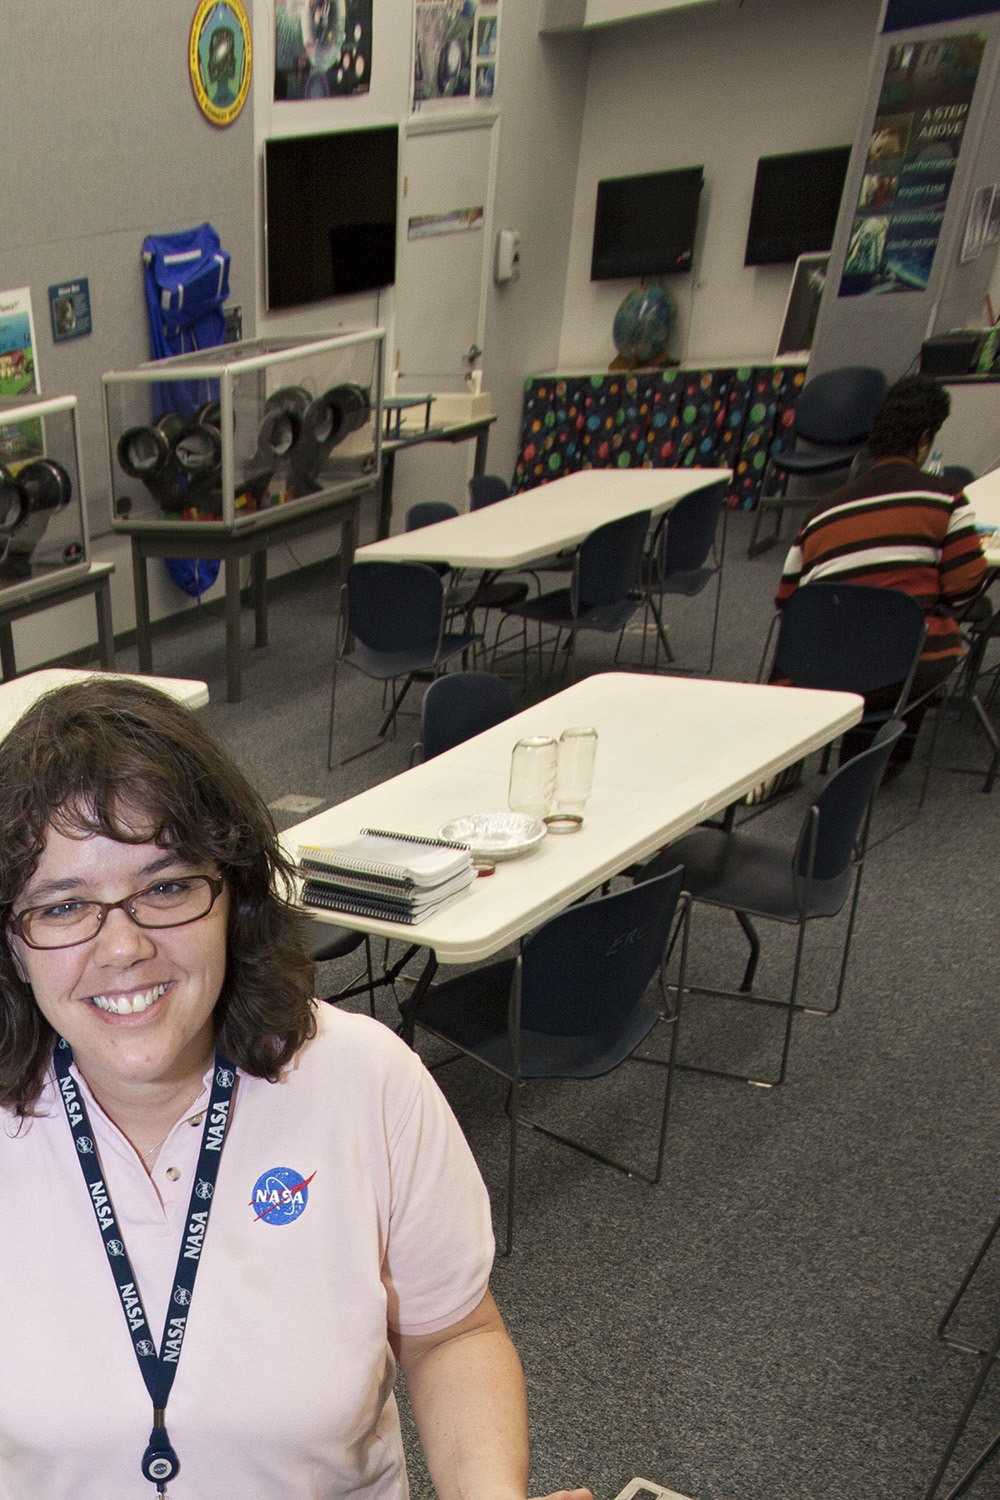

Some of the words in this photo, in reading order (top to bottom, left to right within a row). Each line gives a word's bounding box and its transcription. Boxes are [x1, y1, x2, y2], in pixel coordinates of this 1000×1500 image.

[917, 121, 964, 140] ABOVE
[921, 108, 932, 122] A
[933, 103, 969, 118] STEP
[898, 183, 947, 198] expertise
[60, 1076, 83, 1127] NASA
[206, 1100, 230, 1151] NASA
[90, 1180, 114, 1231] NASA
[256, 1189, 304, 1203] NASA
[184, 1211, 208, 1260] NASA
[120, 1282, 145, 1332] NASA
[163, 1316, 186, 1363] NASA
